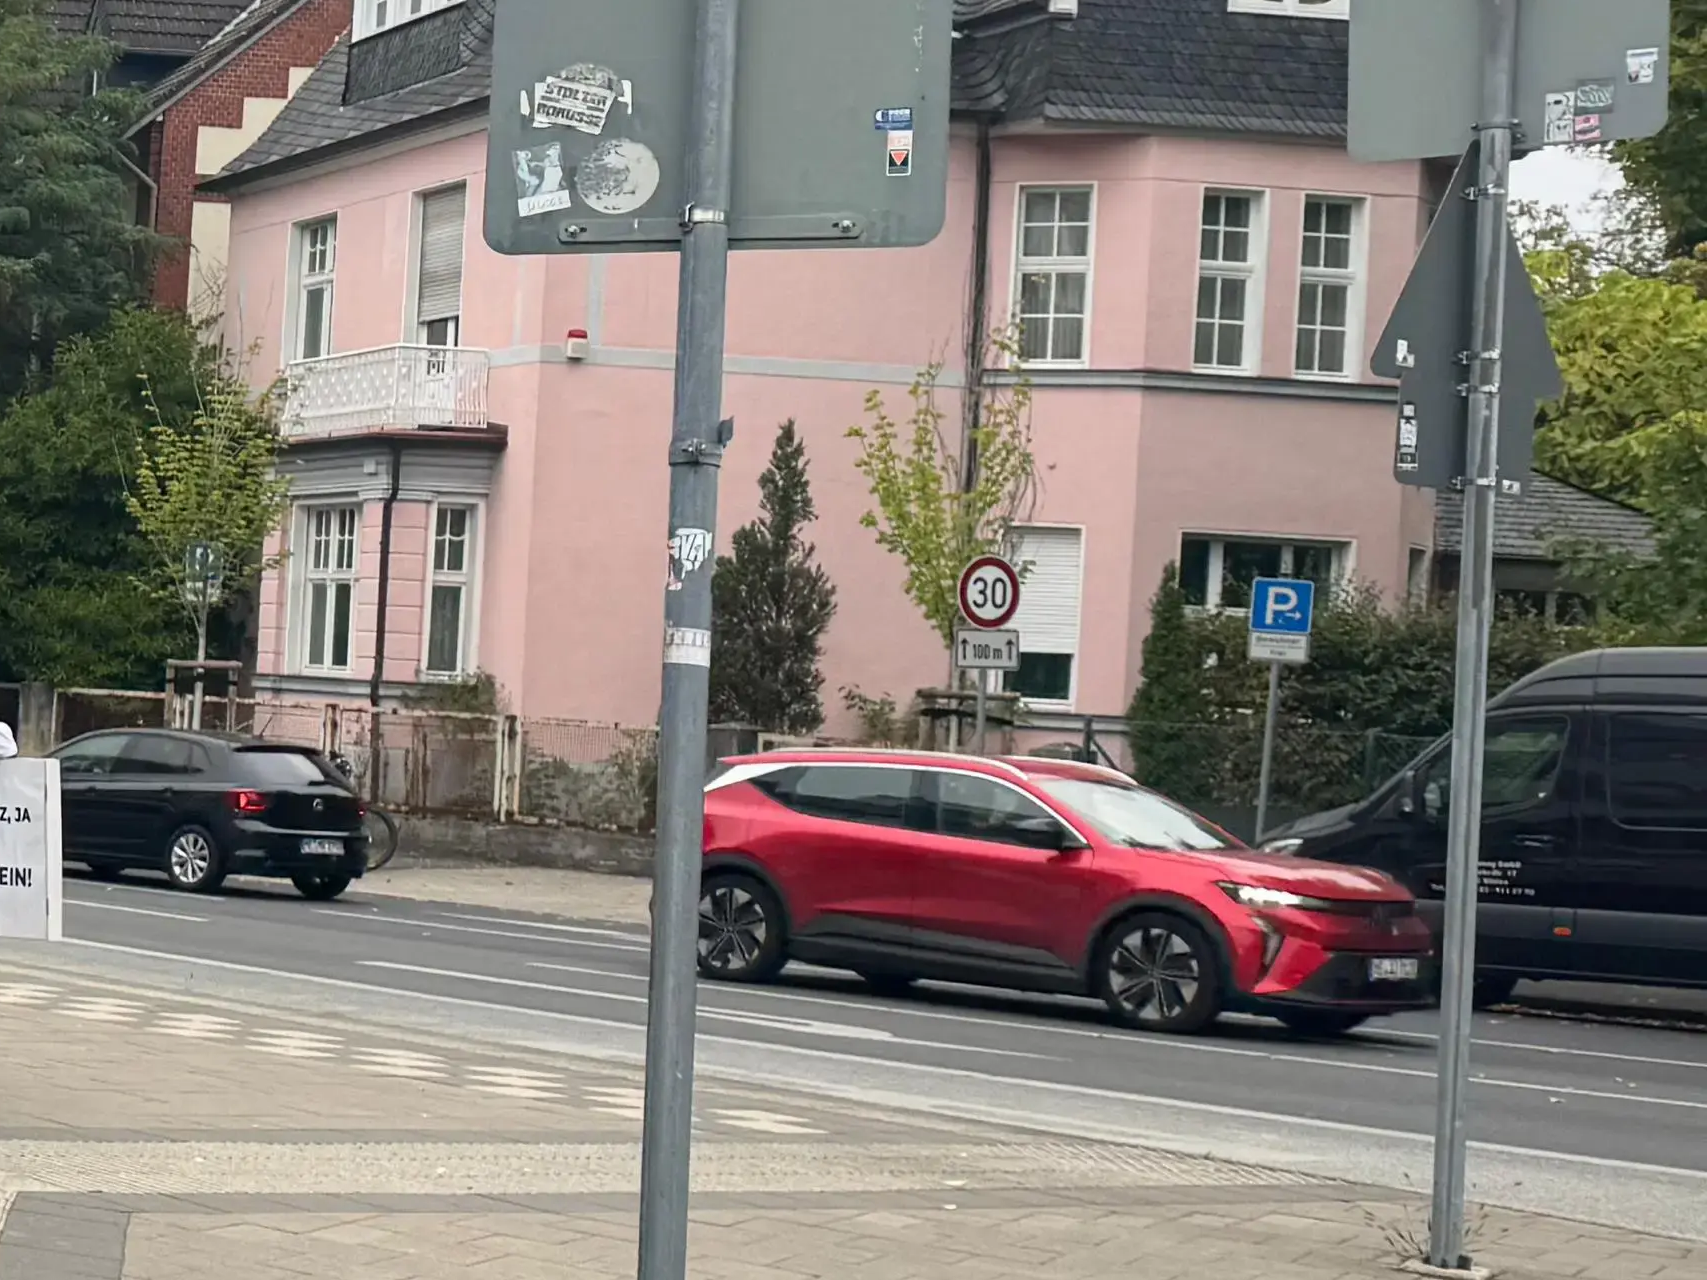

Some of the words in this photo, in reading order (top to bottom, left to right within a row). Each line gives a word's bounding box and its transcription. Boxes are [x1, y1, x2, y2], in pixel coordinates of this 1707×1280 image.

[972, 577, 1007, 609] 30
[1265, 586, 1298, 625] P
[972, 643, 991, 660] 100
[992, 648, 1003, 660] m
[14, 807, 31, 823] JA
